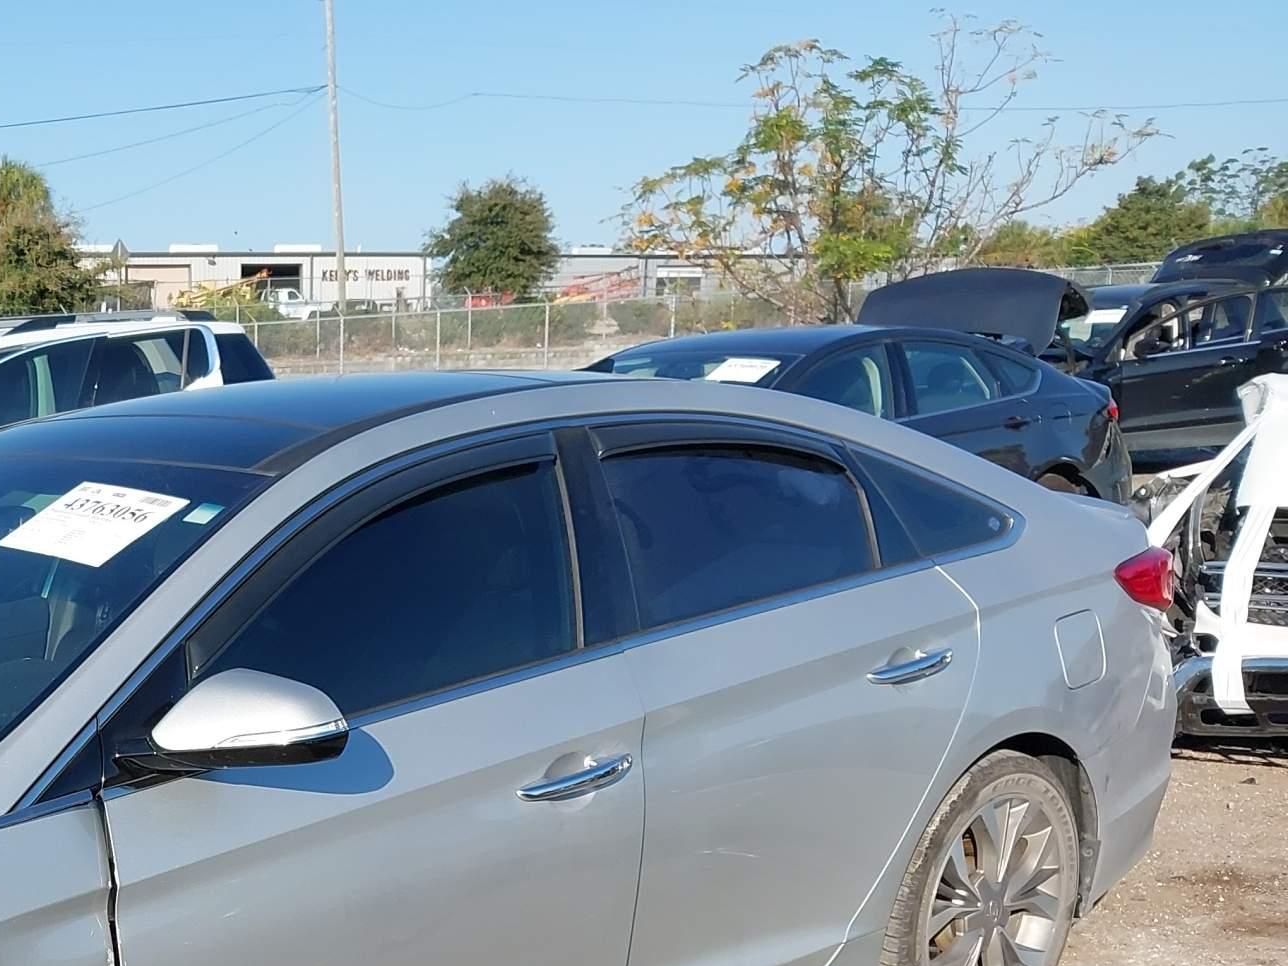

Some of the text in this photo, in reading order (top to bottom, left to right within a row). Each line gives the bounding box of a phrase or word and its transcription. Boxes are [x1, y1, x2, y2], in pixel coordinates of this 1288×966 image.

[322, 269, 410, 282] KEY'S WELDING
[64, 498, 155, 523] 43763056
